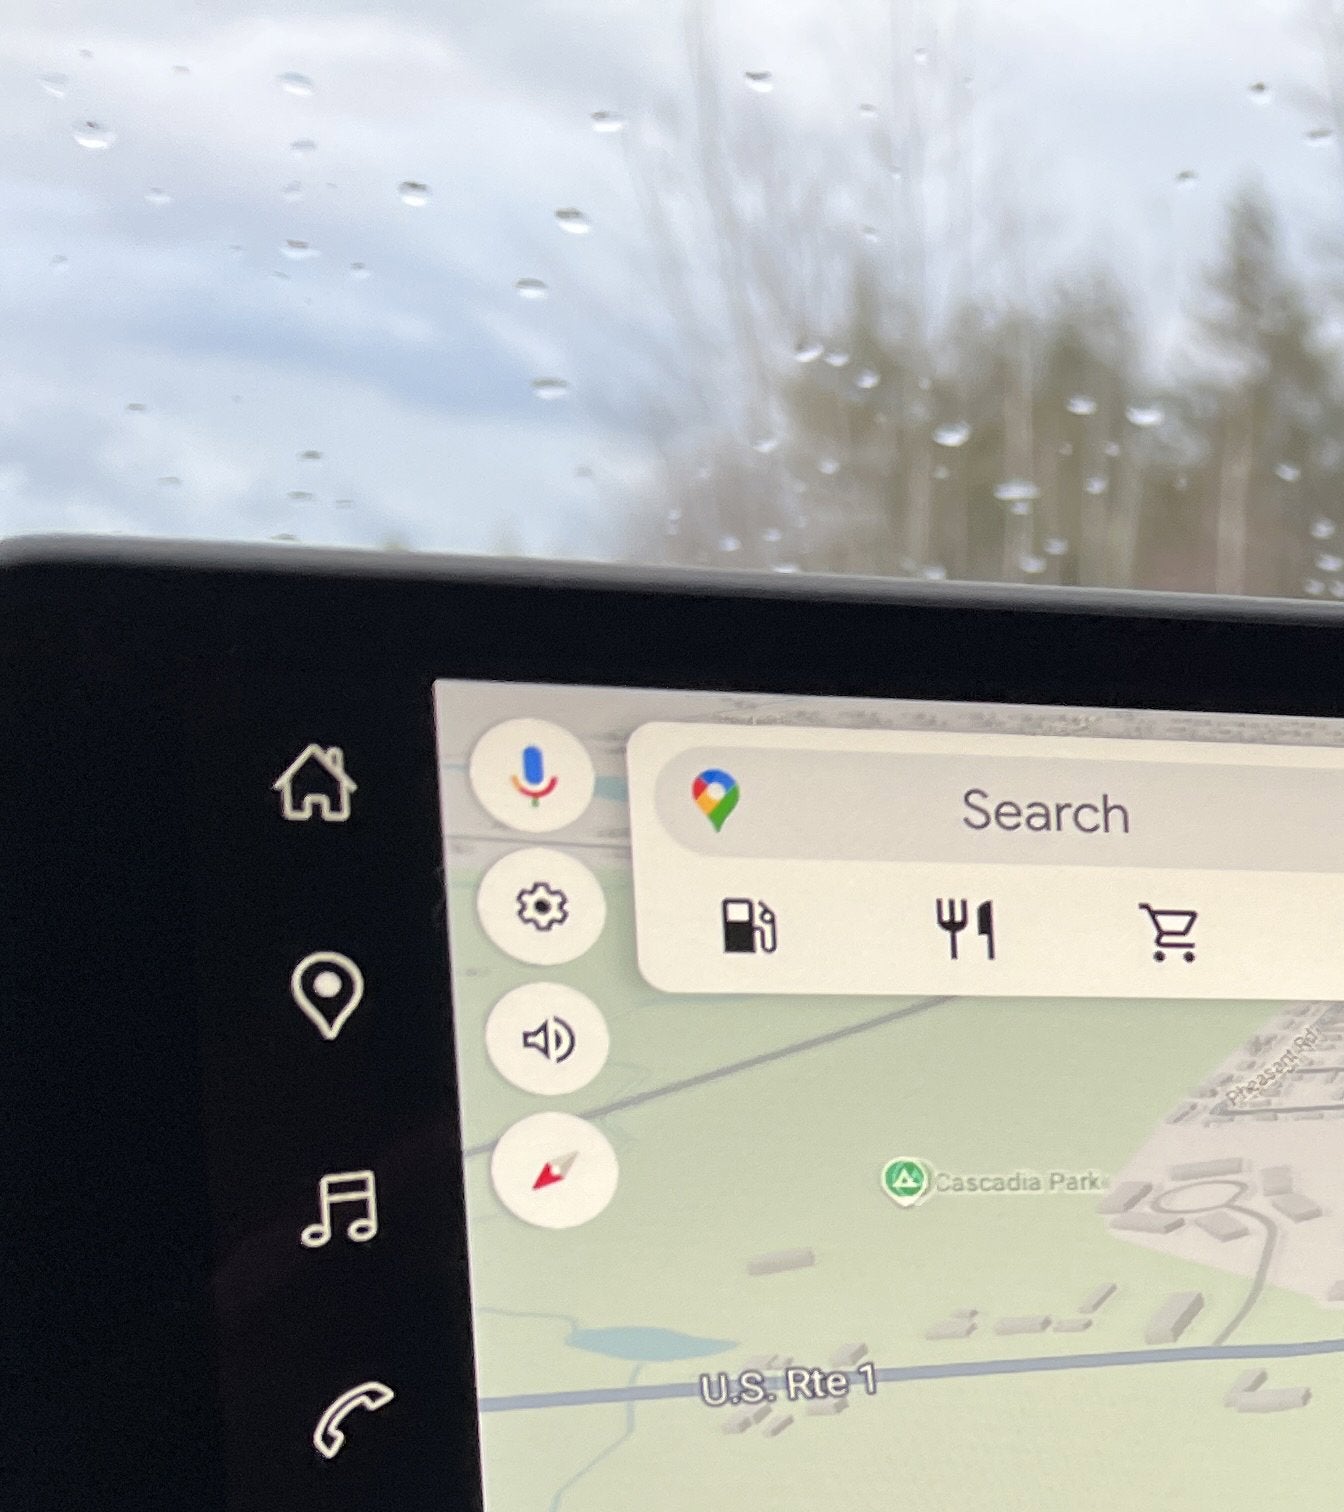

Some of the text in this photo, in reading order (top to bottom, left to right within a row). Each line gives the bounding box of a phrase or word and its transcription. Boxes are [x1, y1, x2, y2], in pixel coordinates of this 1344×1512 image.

[963, 788, 1131, 835] Search
[936, 1171, 1101, 1193] Cascadia Park
[699, 1363, 879, 1406] U.S. Rte 1
